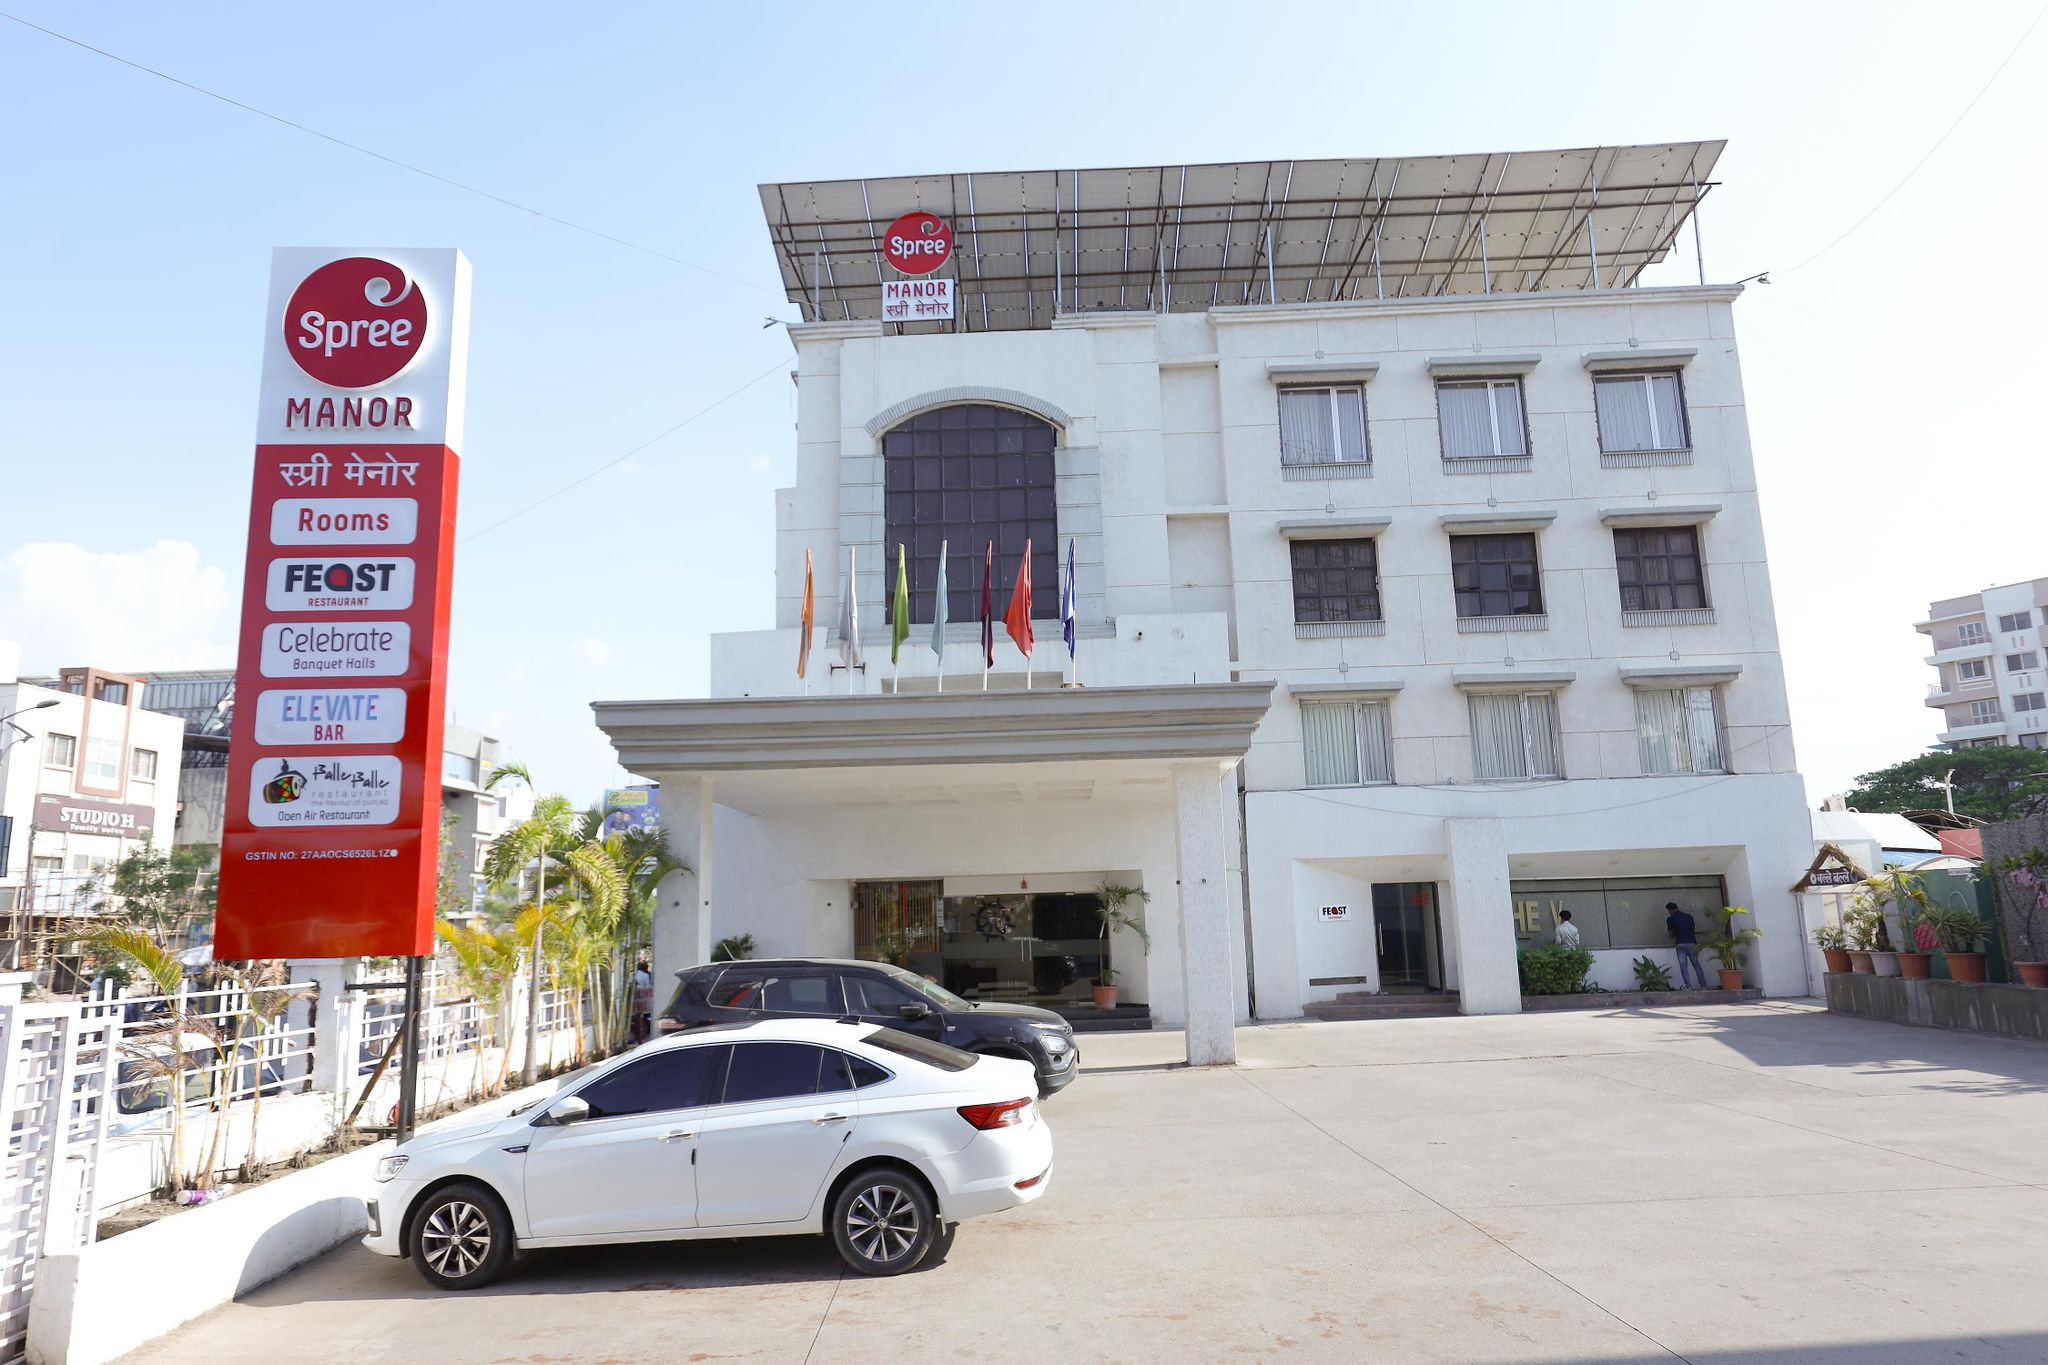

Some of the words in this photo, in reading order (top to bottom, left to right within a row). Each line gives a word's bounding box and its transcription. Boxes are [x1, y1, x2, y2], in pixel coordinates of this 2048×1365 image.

[891, 236, 946, 260] Spree
[887, 282, 947, 298] MANOR
[915, 299, 949, 316] मेनोर
[298, 310, 413, 357] Spree
[286, 396, 413, 428] MANOR
[279, 452, 333, 488] स्प्री
[343, 452, 420, 487] मेनोर
[298, 507, 390, 532] Rooms
[285, 563, 396, 592] FEAST
[307, 597, 369, 607] RESTAURANT
[278, 626, 393, 653] Celebrate
[293, 659, 343, 671] Banquet
[346, 657, 376, 669] Halls
[282, 695, 379, 721] ELEVATE
[313, 724, 344, 741] BAR
[312, 762, 351, 781] Balle
[351, 770, 390, 789] Balle
[311, 790, 388, 799] restaurant
[60, 807, 120, 826] STUDIO
[303, 810, 317, 820] Air
[319, 810, 370, 820] Restaurant
[246, 852, 277, 860] GSTIN
[279, 851, 298, 860] NO:
[1323, 906, 1346, 915] FEAST
